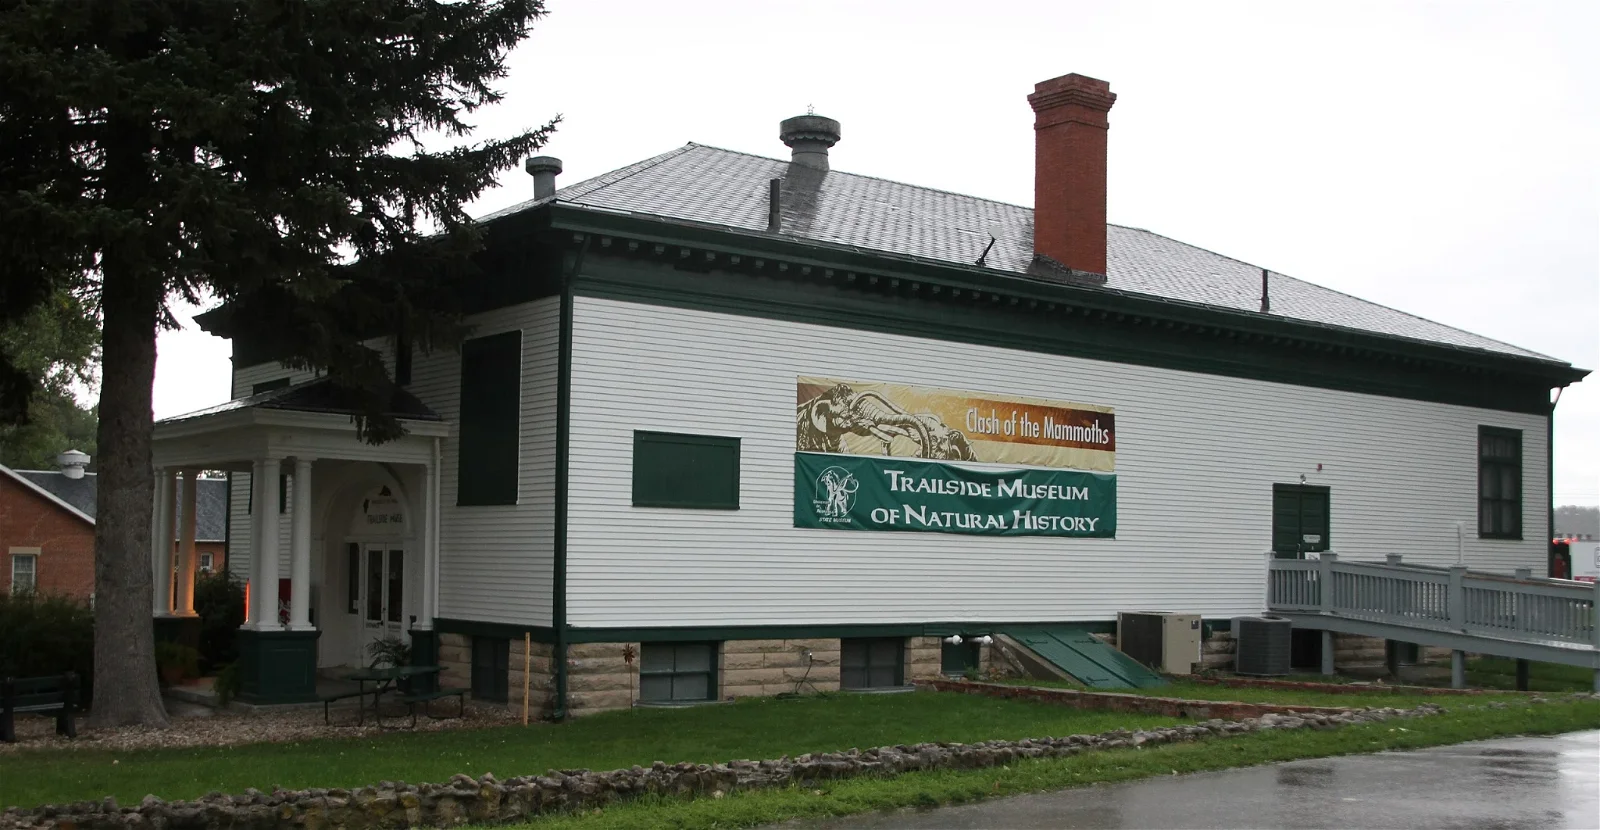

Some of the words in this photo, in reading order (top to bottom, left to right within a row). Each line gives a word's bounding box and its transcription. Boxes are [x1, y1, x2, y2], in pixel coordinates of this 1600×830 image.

[966, 407, 999, 435] Clash
[1003, 410, 1017, 436] of
[1020, 412, 1040, 438] the
[1043, 416, 1109, 445] Mammoths
[883, 469, 992, 497] TRAILSIDE
[997, 478, 1089, 500] MUSEUM
[870, 507, 900, 525] OF
[902, 504, 1009, 529] NATURAL
[1012, 509, 1100, 532] HISTORY
